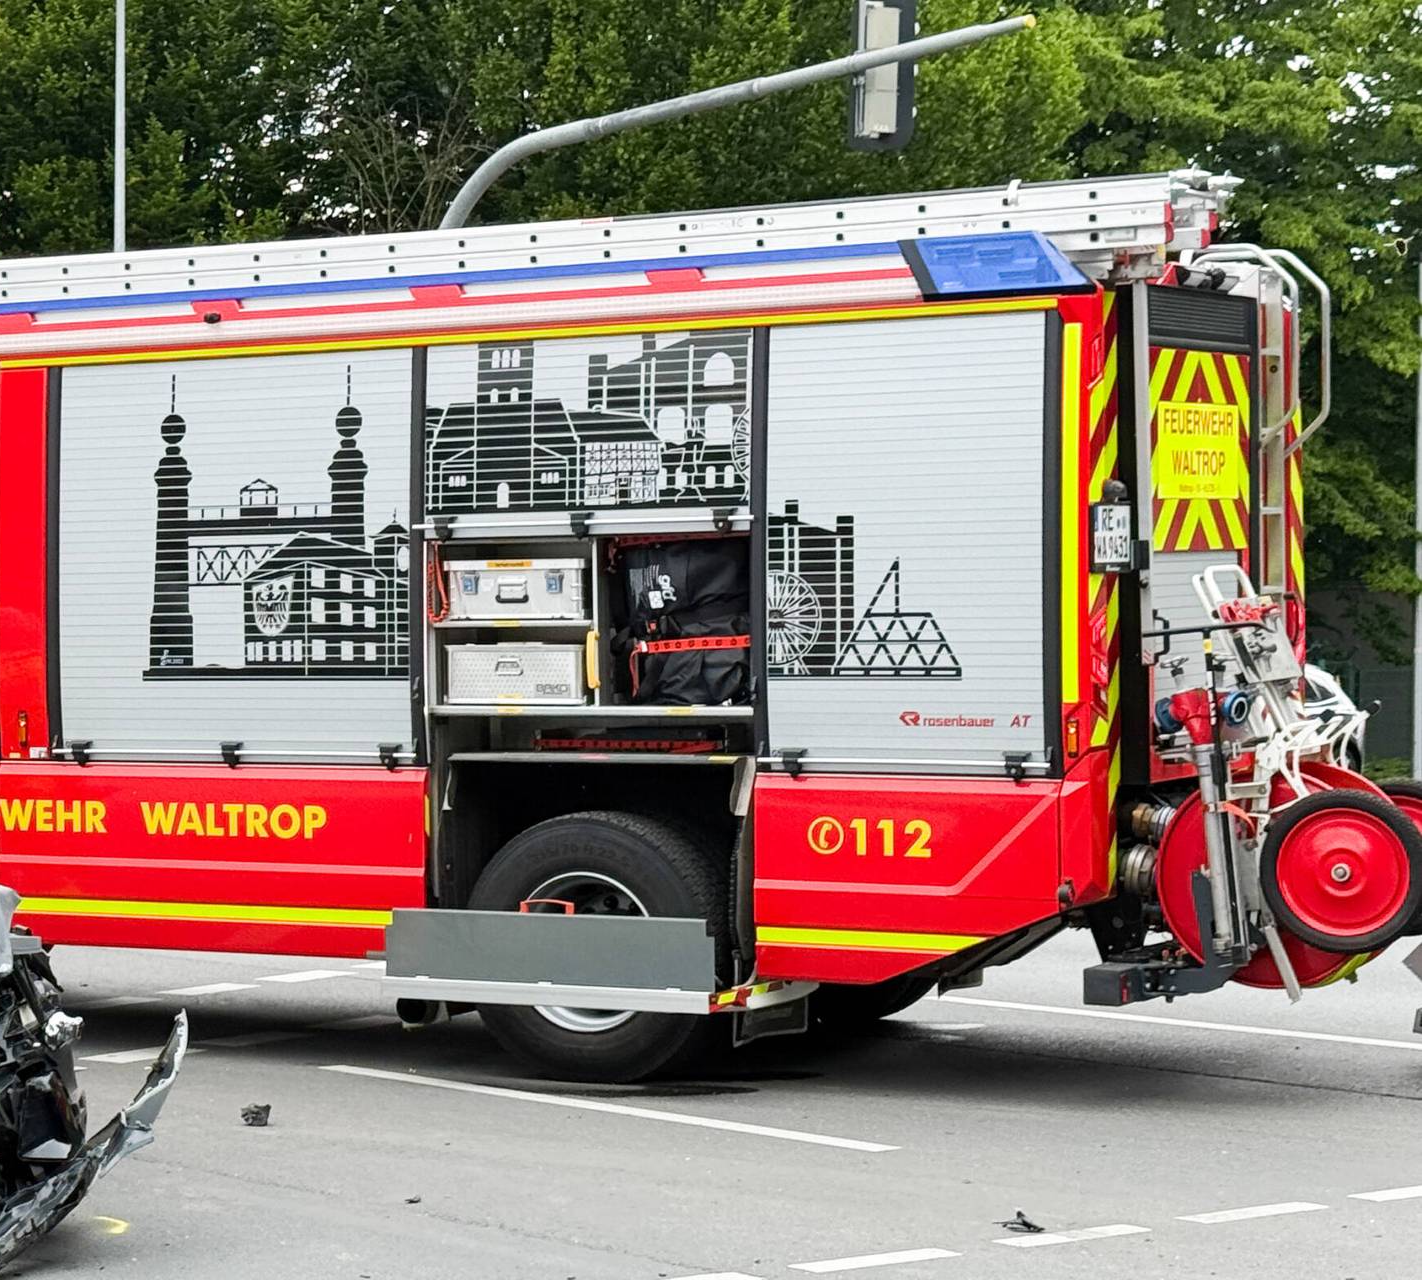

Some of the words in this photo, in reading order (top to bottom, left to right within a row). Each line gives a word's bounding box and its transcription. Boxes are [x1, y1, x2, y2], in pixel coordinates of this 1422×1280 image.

[1163, 408, 1234, 437] FEUERWEHR
[1171, 450, 1226, 476] WALTROP
[1102, 508, 1115, 532] RE
[923, 714, 995, 728] rosenbauer
[1010, 714, 1032, 728] AT
[140, 802, 327, 839] WALTROP
[849, 818, 932, 858] 112
